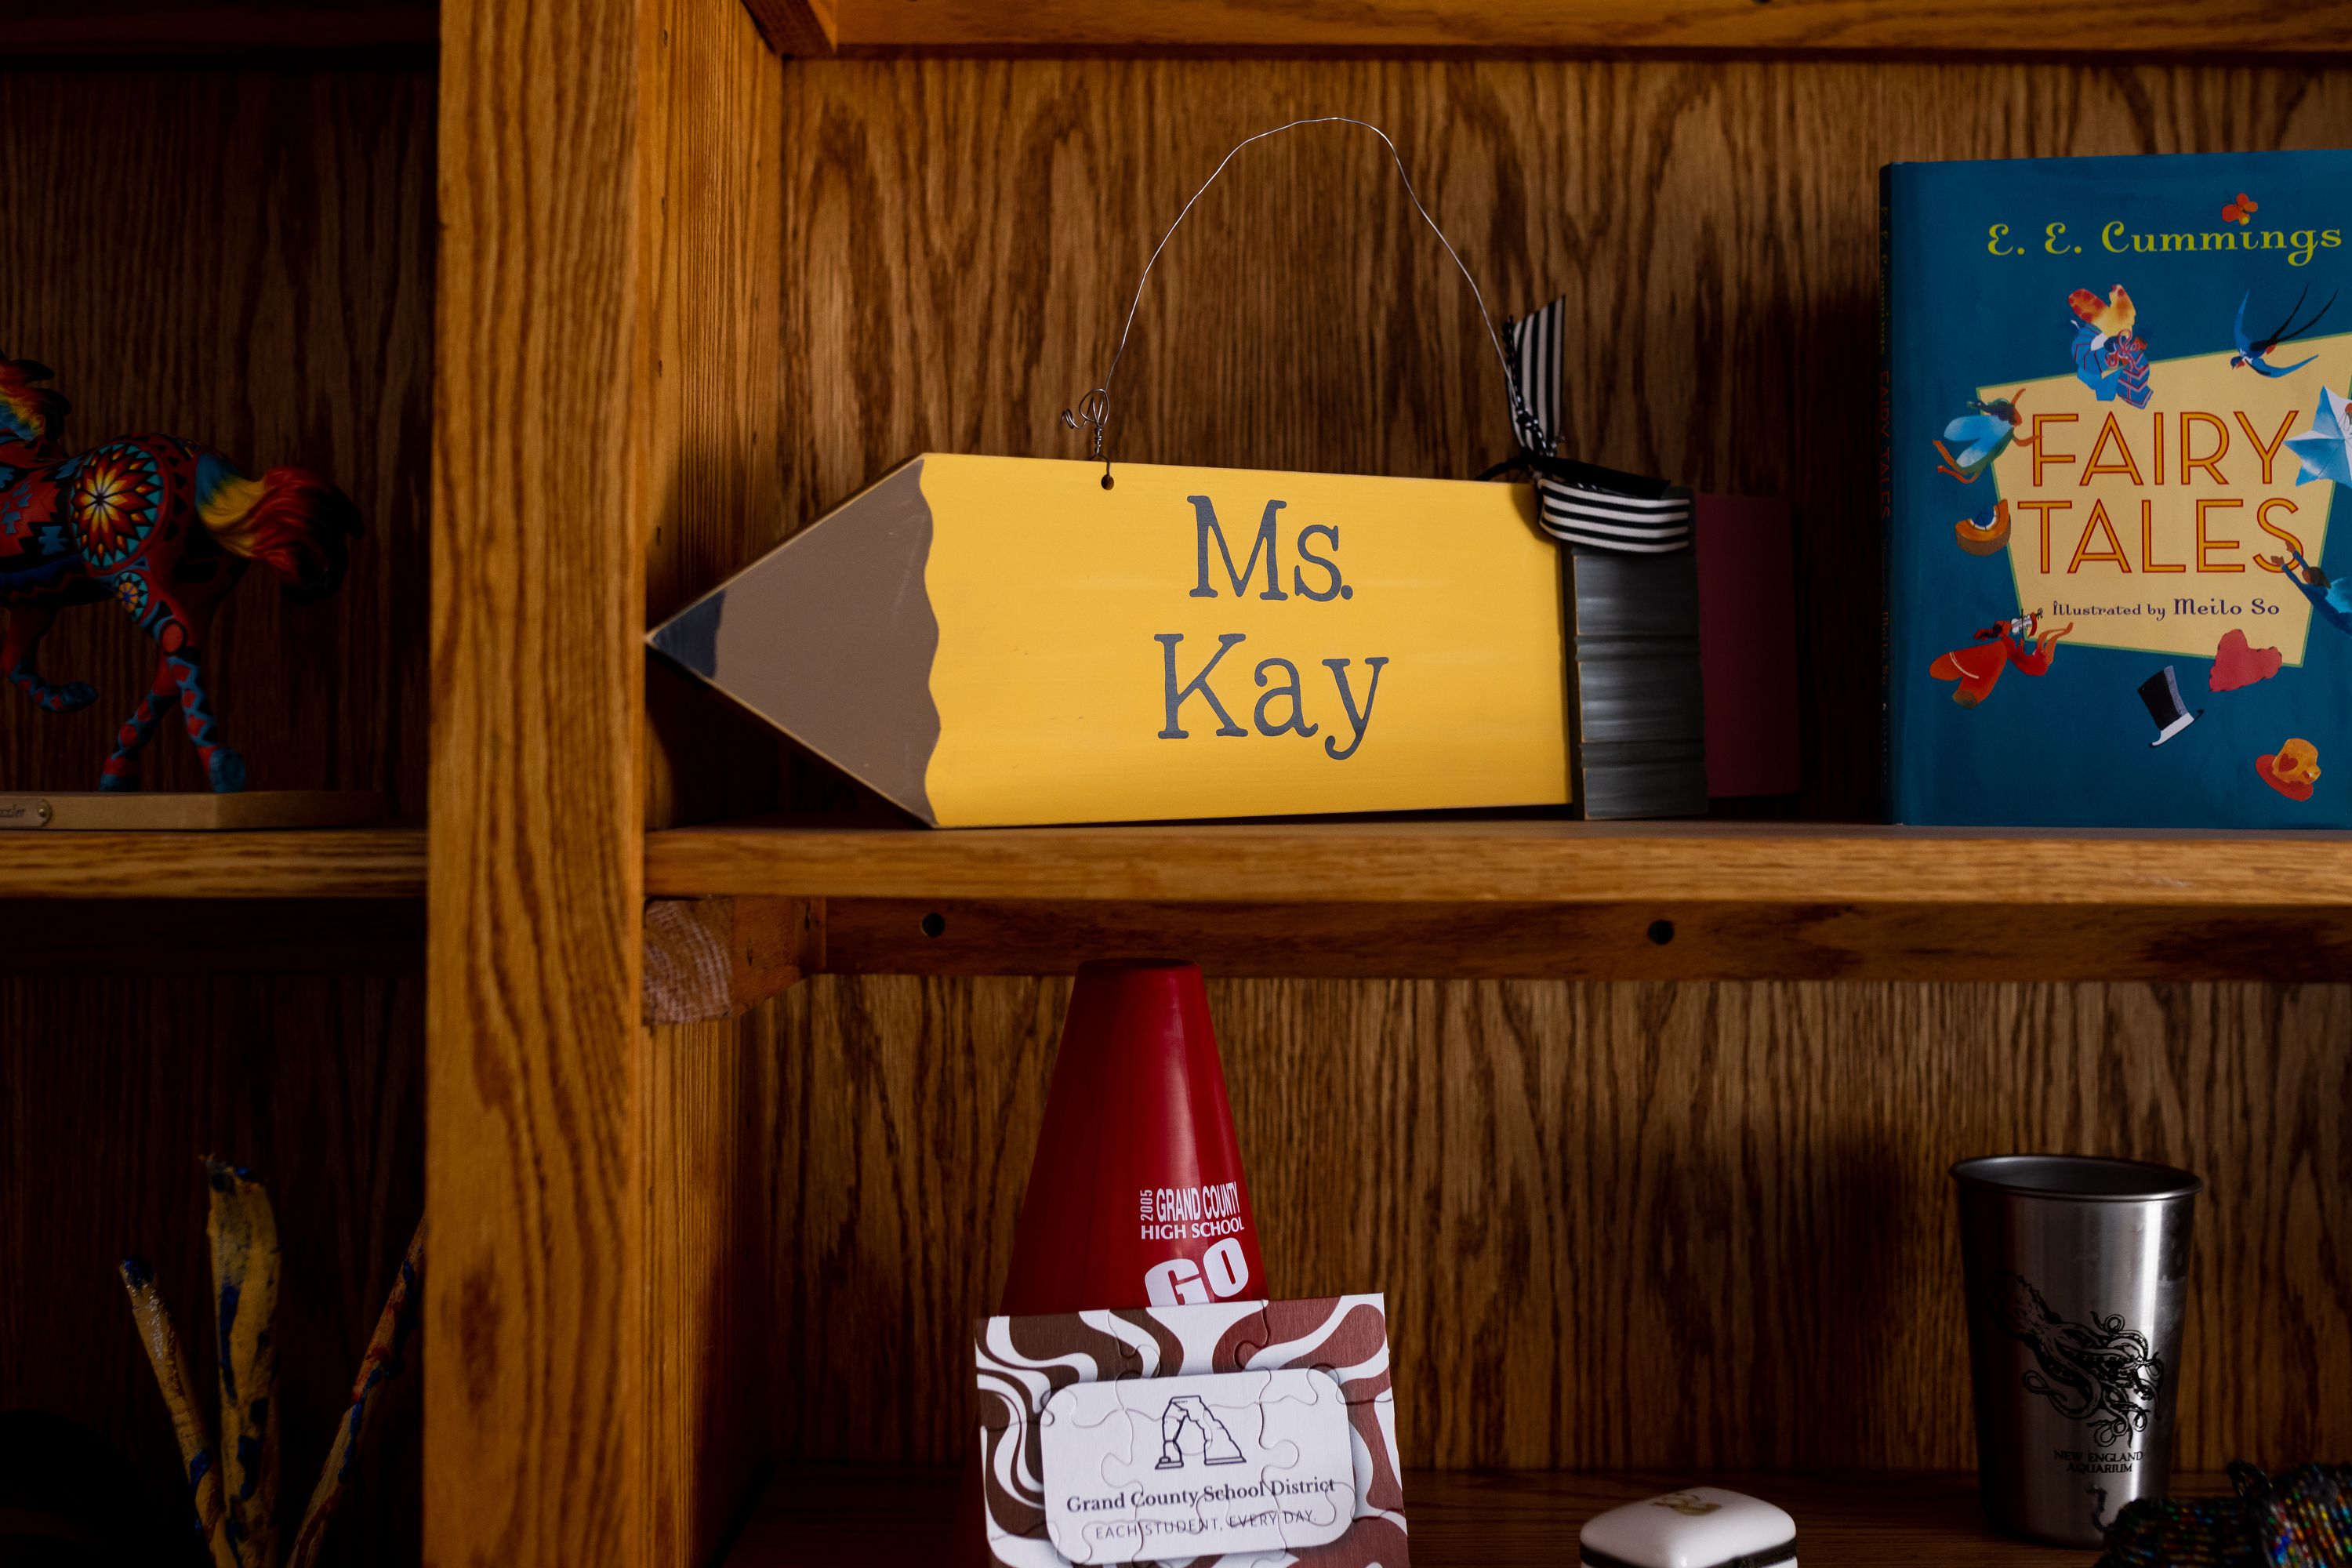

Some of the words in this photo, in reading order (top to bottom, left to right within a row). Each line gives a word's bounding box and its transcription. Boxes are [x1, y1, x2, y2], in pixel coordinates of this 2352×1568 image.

[1987, 223, 2025, 256] E.
[2045, 222, 2082, 255] E.
[2102, 220, 2343, 267] Cummings
[2032, 410, 2299, 488] FAIRY
[1881, 445, 1891, 519] TALES
[1187, 495, 1354, 602] Ms.
[2017, 497, 2304, 574] TALES
[2053, 601, 2141, 615] Illustrated
[2147, 604, 2165, 622] by
[2173, 598, 2242, 615] Meilo
[2251, 598, 2280, 615] So
[1154, 633, 1389, 760] Kay
[1140, 1189, 1153, 1221] 2005
[1156, 1188, 1201, 1222] GRAND
[1202, 1181, 1240, 1220] COUNTY
[1141, 1224, 1186, 1240] HIGH
[1191, 1216, 1245, 1239] SCHOOL
[1145, 1237, 1249, 1307] GO
[2054, 1450, 2083, 1461] NEW
[2088, 1451, 2143, 1462] ENGLAND
[2067, 1463, 2132, 1474] AQUARIUM
[1066, 1491, 1126, 1513] Grand
[1131, 1489, 1200, 1509] County
[1203, 1481, 1266, 1502] School
[1271, 1477, 1336, 1496] District
[1096, 1524, 1138, 1540] EACH
[1145, 1517, 1223, 1535] STUDENT,
[1229, 1511, 1278, 1528] EVERY
[1283, 1509, 1317, 1524] DAY.
